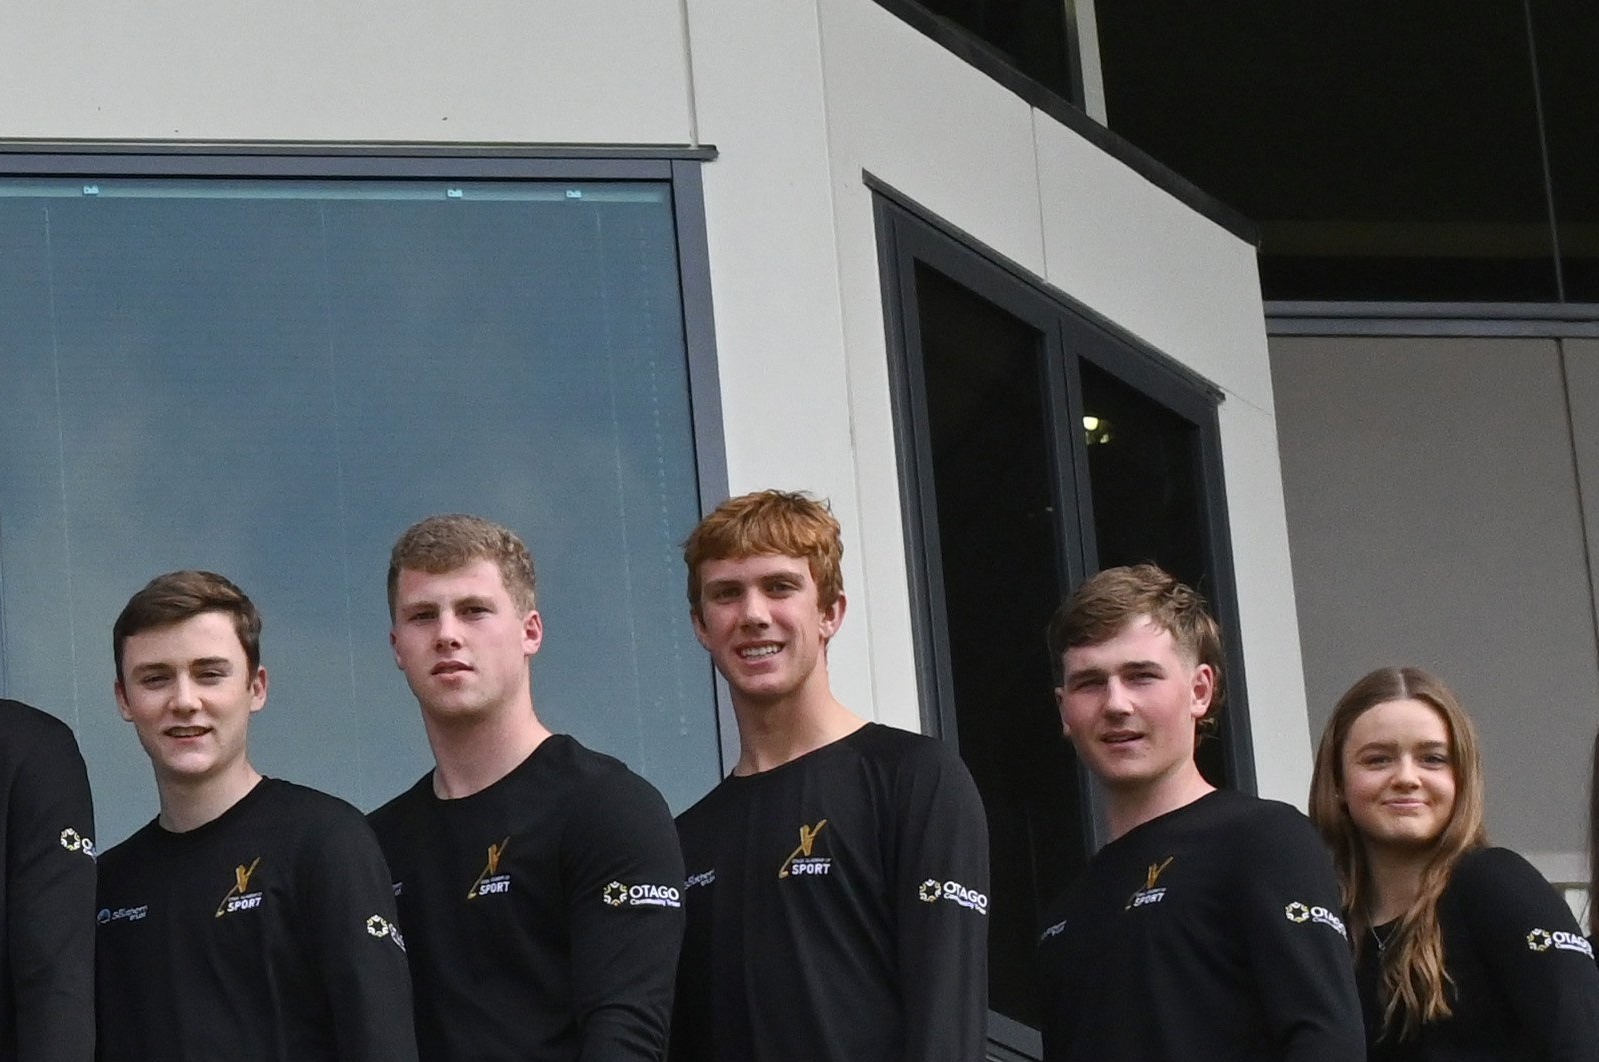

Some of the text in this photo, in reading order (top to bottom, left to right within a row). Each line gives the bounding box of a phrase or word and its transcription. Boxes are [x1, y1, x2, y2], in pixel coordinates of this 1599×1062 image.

[791, 863, 831, 875] SPORT
[478, 881, 511, 896] SPORT
[629, 885, 680, 901] OTAGO
[943, 881, 988, 908] OTAGO
[227, 897, 262, 912] SPORT
